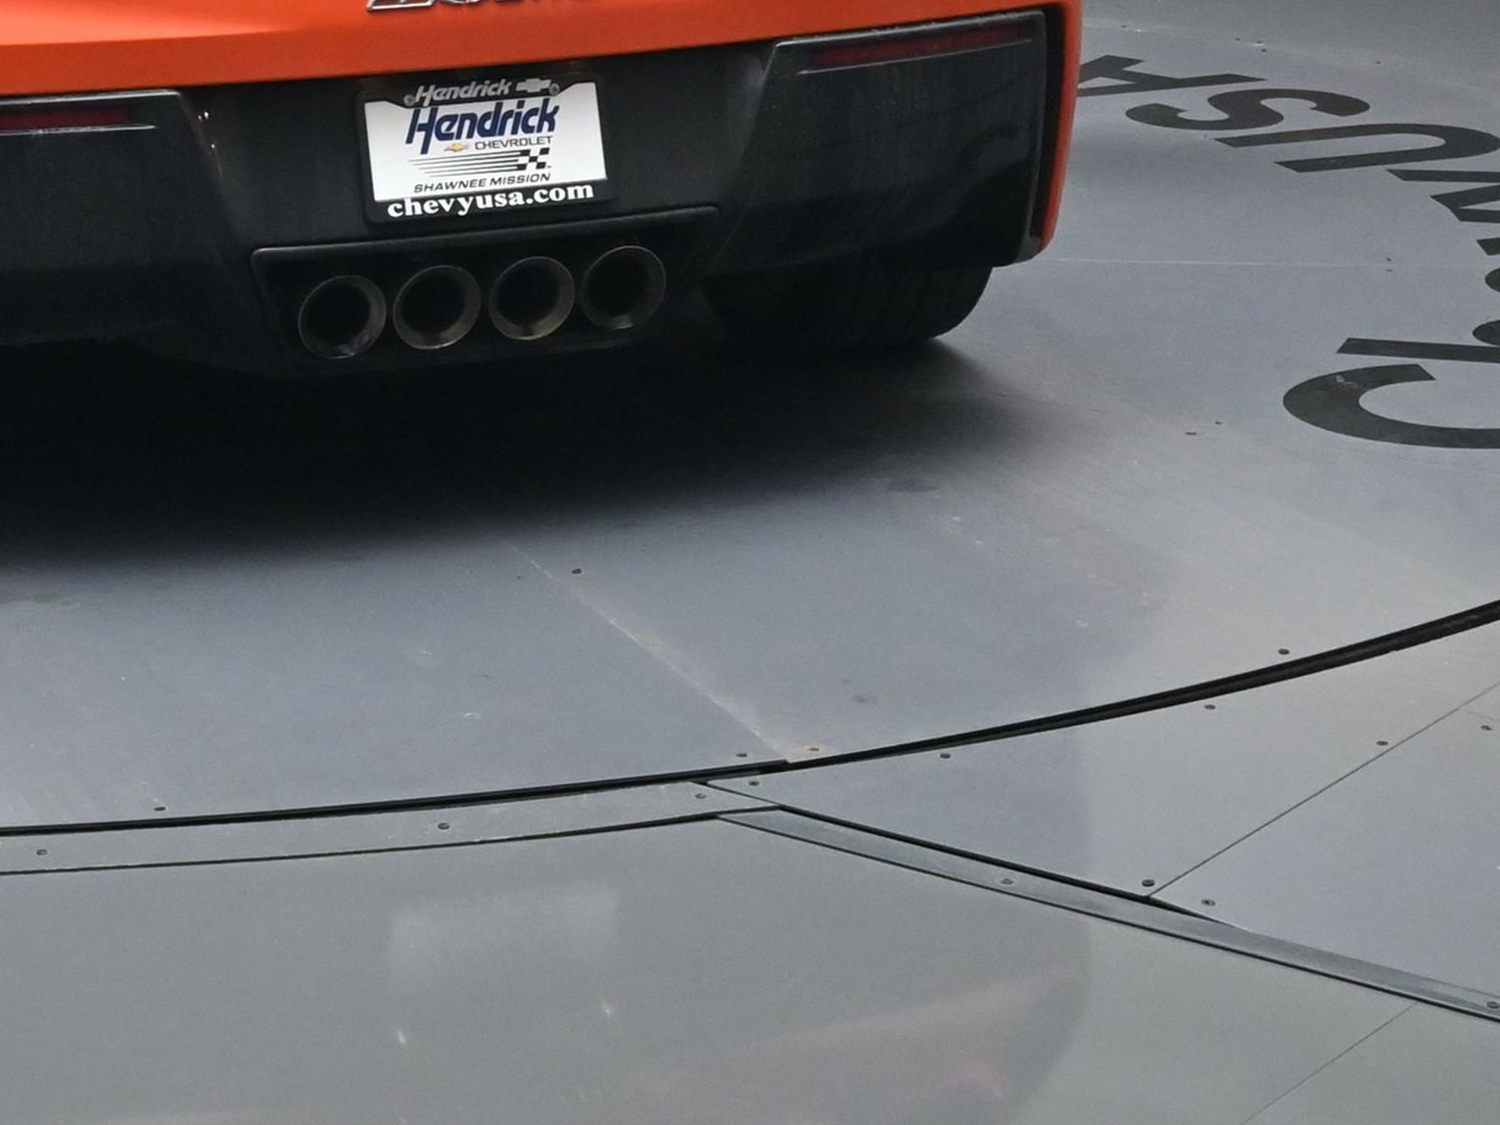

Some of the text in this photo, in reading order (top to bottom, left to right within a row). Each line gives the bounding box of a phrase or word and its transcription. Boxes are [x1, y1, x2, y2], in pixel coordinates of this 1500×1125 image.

[415, 78, 512, 107] Hendrick
[405, 98, 560, 155] Hendrick
[475, 136, 554, 150] CHEVROLET
[413, 173, 551, 193] SHAWNEE MISSION
[387, 184, 594, 218] chevyusa.com
